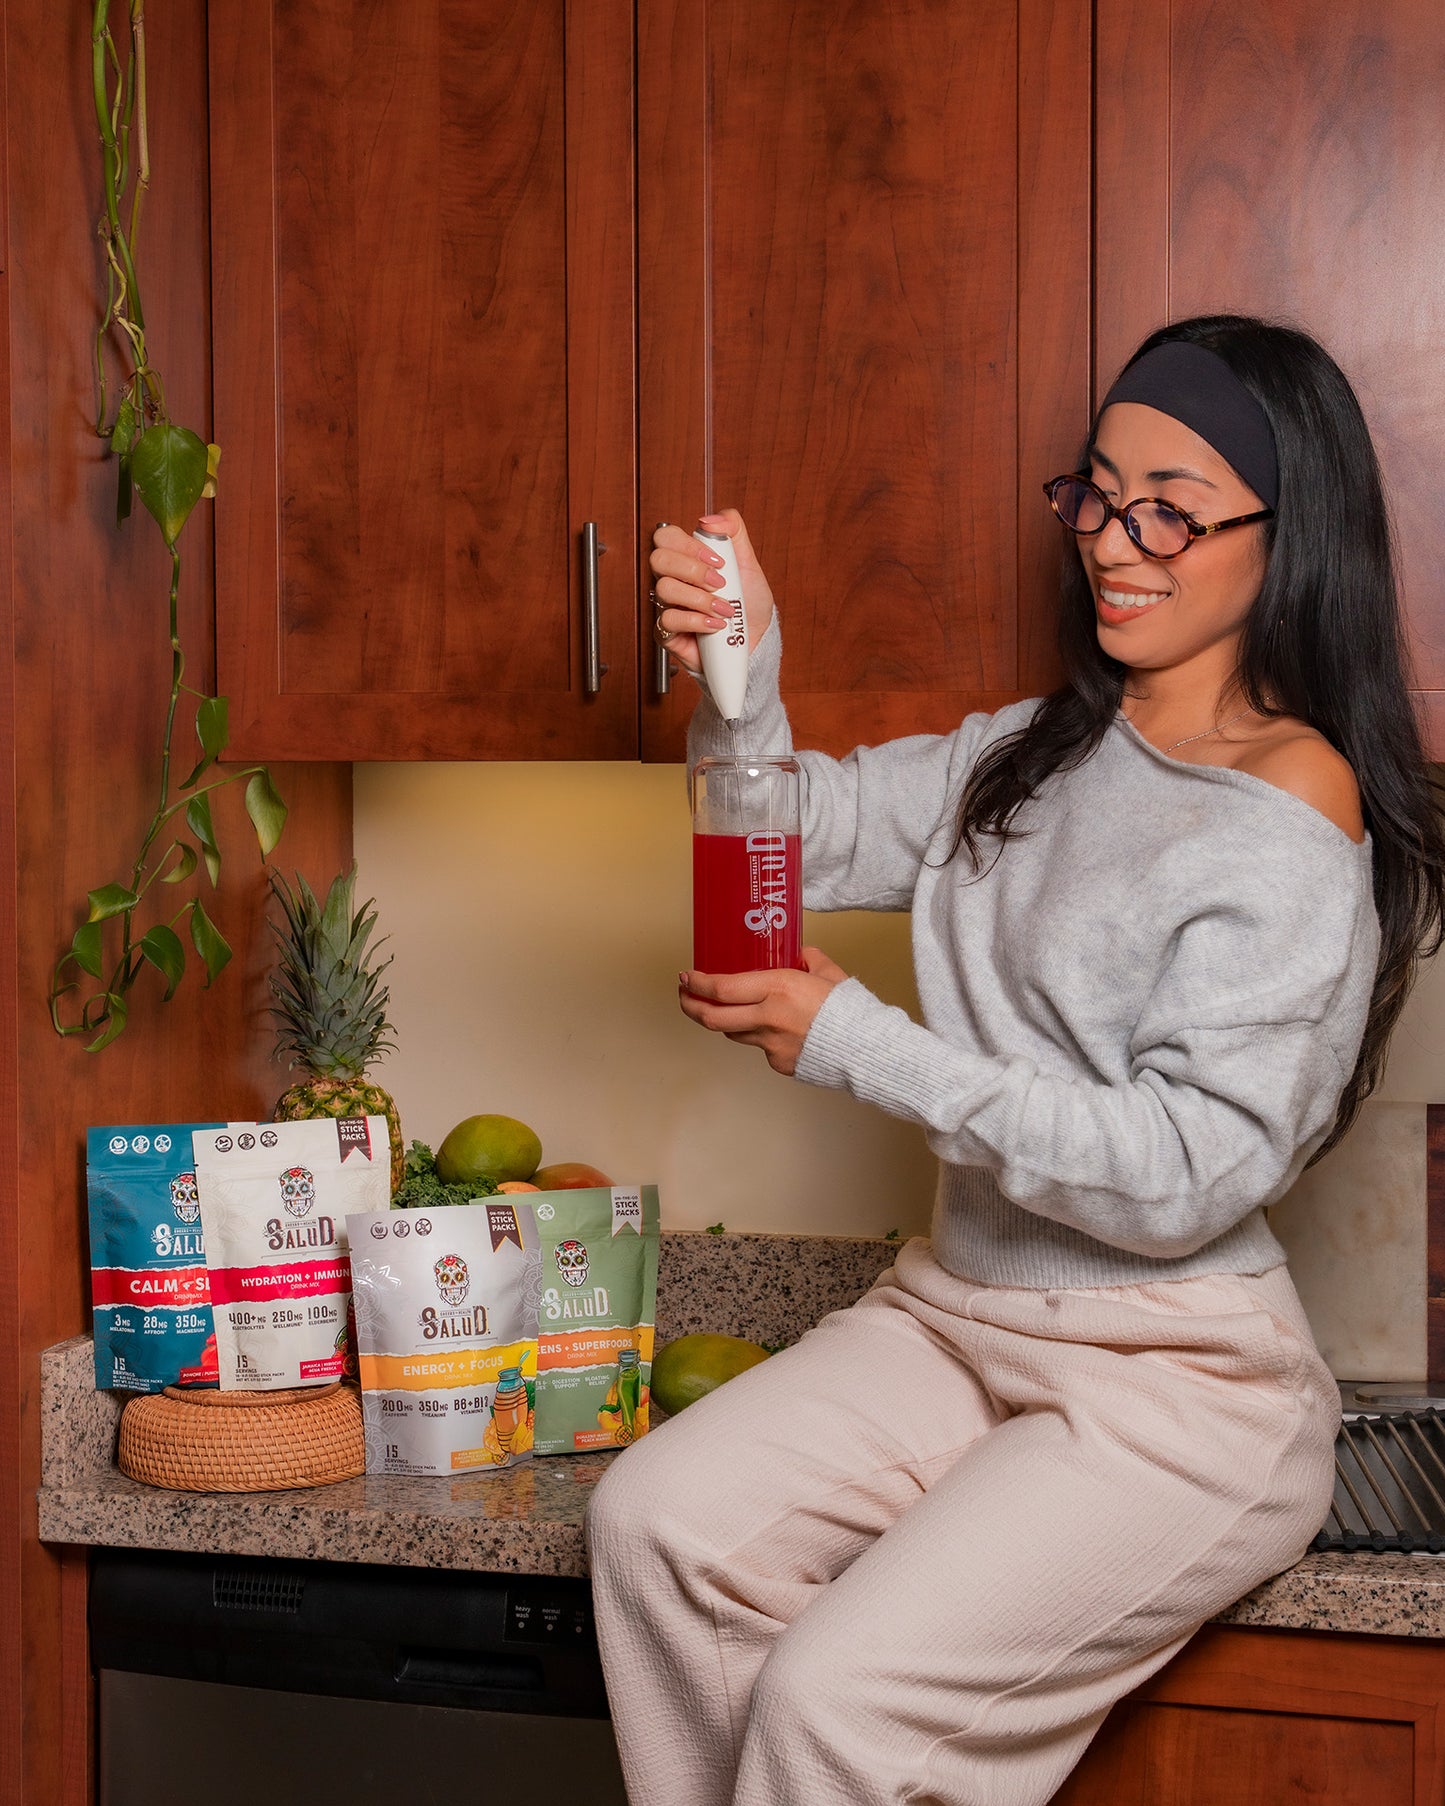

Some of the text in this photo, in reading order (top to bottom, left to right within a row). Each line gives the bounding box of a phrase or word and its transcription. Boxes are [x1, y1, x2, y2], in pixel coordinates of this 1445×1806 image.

[744, 830, 787, 938] SALUD
[340, 1125, 365, 1133] STICK
[341, 1133, 367, 1141] PACKS
[615, 1201, 639, 1209] STICK
[616, 1209, 640, 1217] PACKS
[490, 1216, 514, 1224] STICK
[492, 1223, 517, 1231] PACKS
[241, 1273, 302, 1287] HYDRATION
[130, 1279, 179, 1293] CALM
[290, 1282, 309, 1290] DRINK
[572, 1338, 633, 1352] SUPERFOODS
[114, 1356, 126, 1371] 15
[237, 1355, 249, 1368] 15
[403, 1362, 455, 1377] ENERGY
[470, 1355, 504, 1371] FOCUS
[386, 1445, 398, 1458] 15
[515, 1605, 531, 1614] heavy
